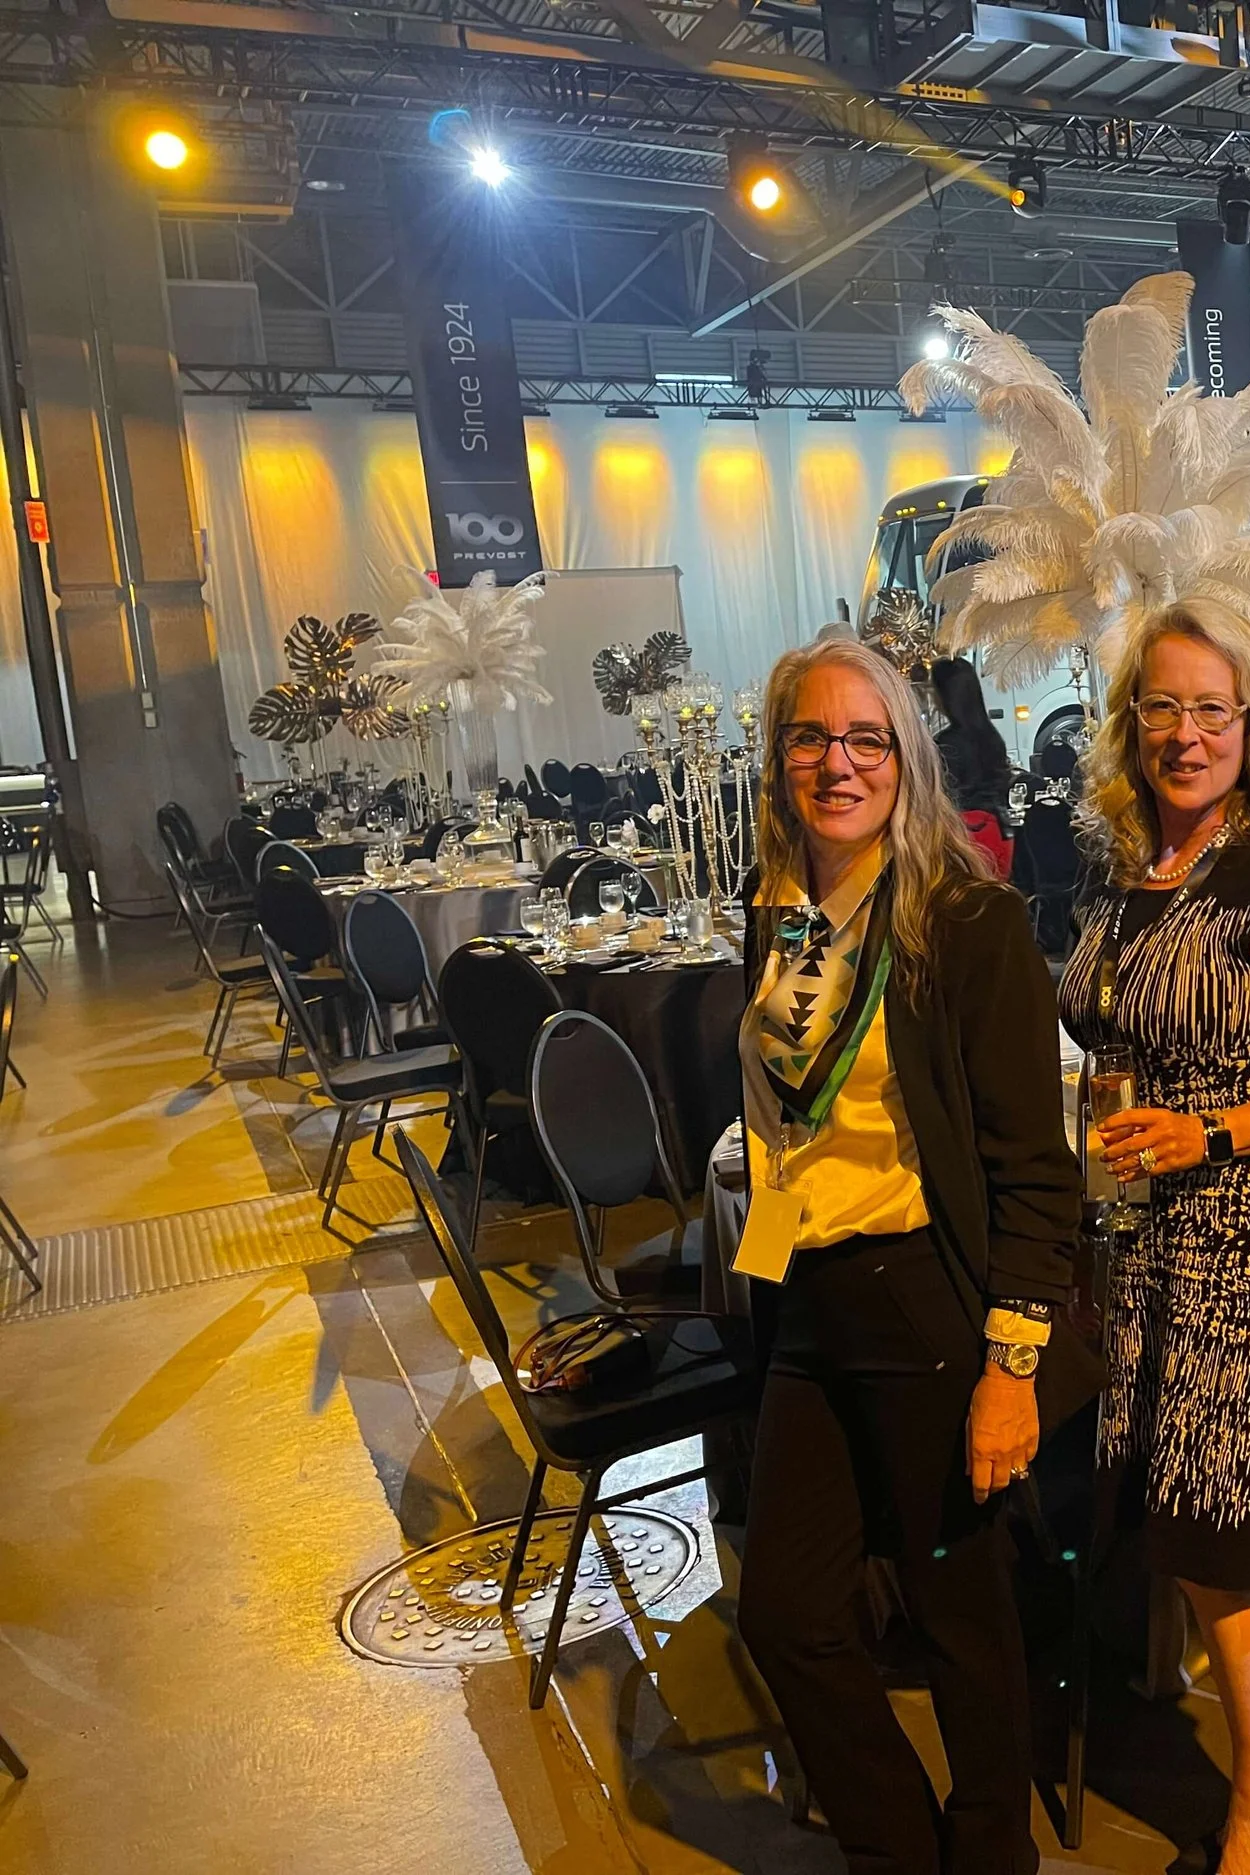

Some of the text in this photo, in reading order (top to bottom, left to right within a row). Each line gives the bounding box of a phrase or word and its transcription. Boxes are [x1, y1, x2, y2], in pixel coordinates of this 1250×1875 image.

[443, 301, 488, 452] Since 1924
[445, 512, 525, 546] 100
[453, 551, 527, 560] PREVOST
